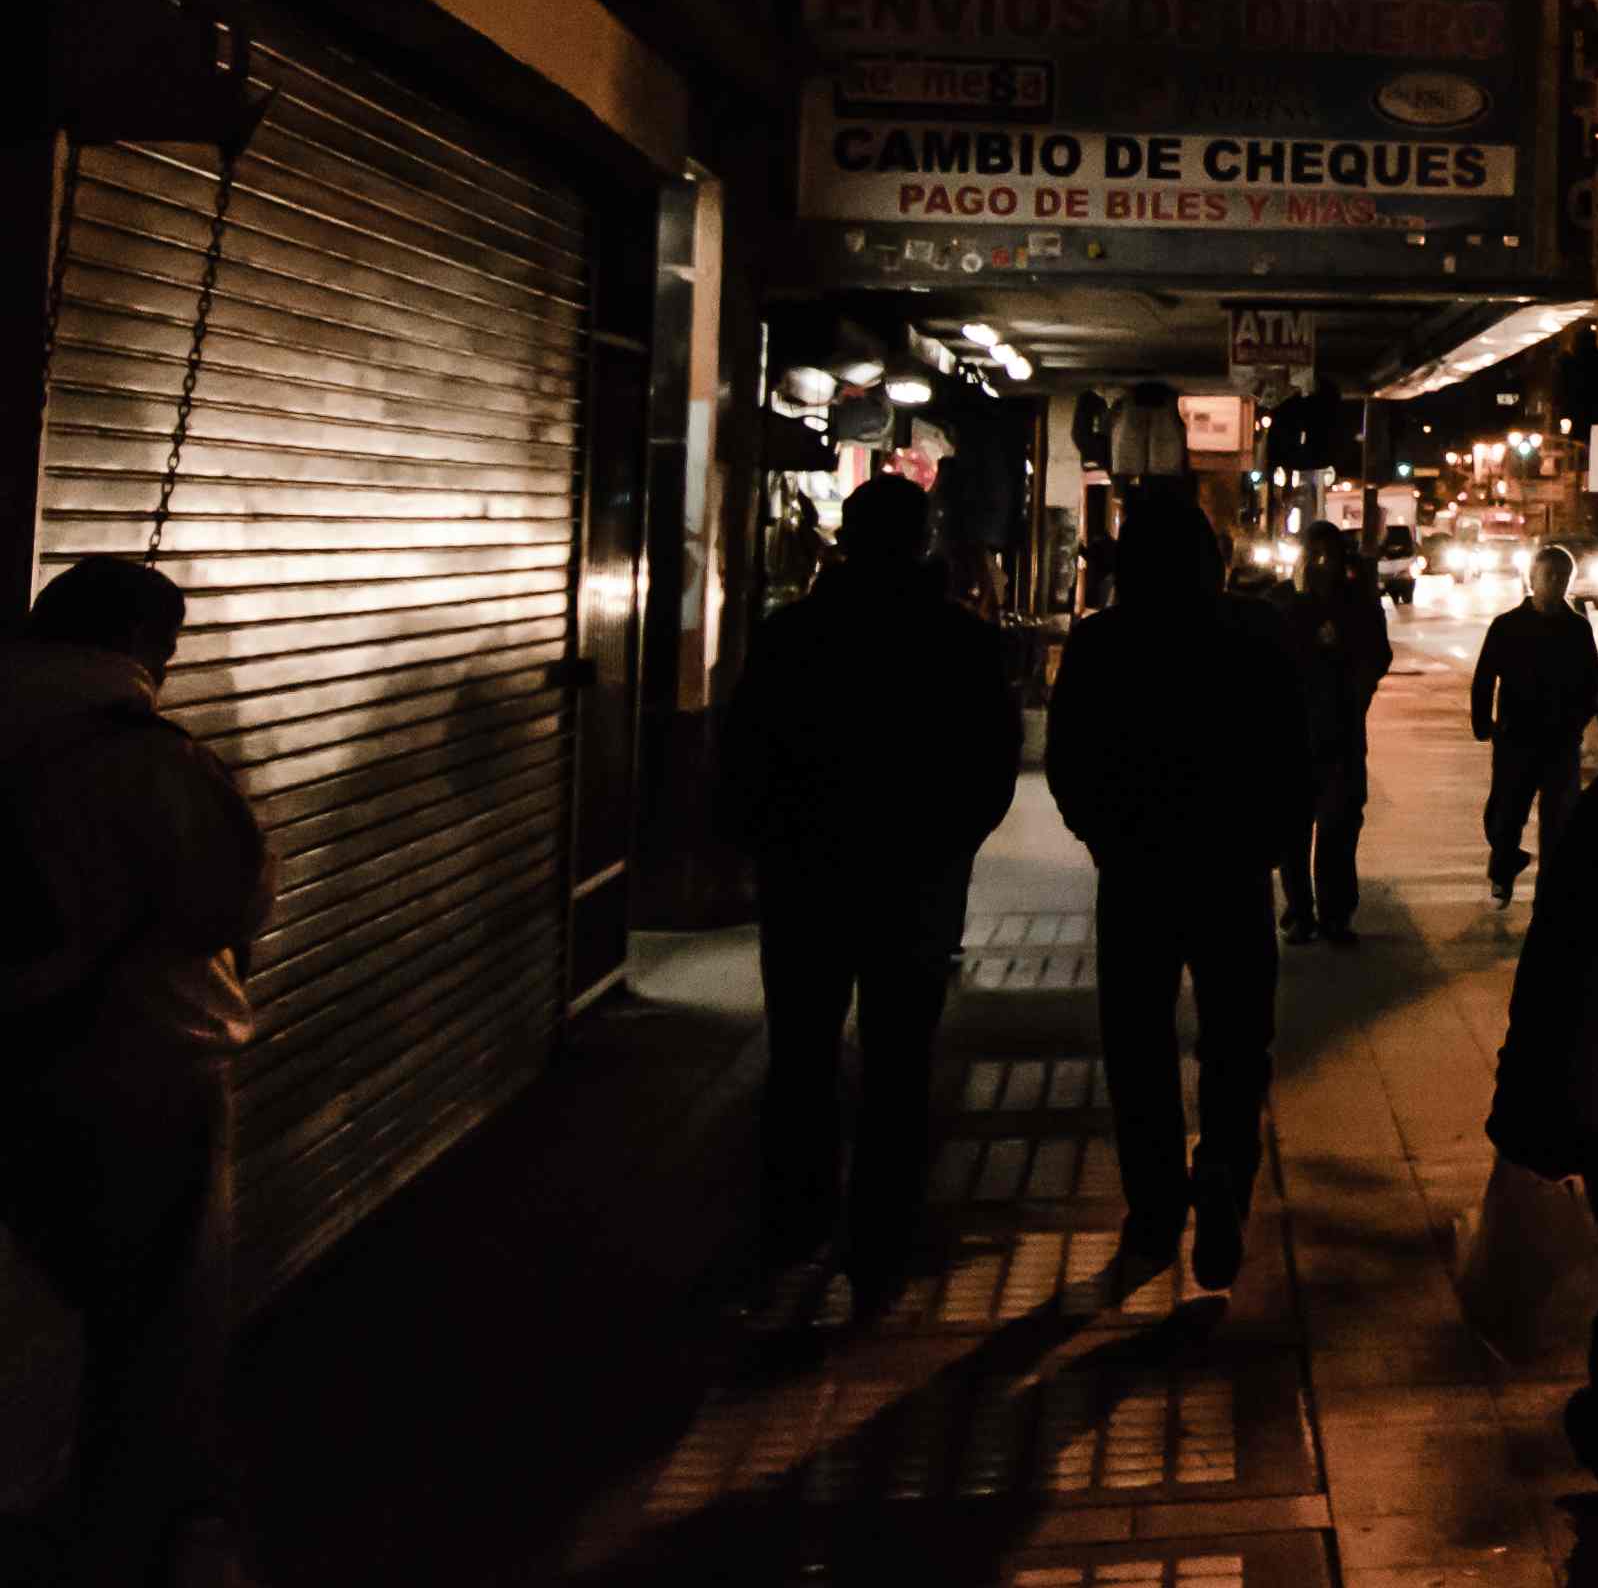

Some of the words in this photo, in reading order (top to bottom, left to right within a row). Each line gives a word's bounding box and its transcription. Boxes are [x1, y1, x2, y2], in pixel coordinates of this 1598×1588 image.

[834, 128, 1082, 178] CAMBIO
[1104, 136, 1181, 180] DE
[1202, 140, 1487, 188] CHEQUES
[899, 184, 1018, 217] PAGO
[1035, 188, 1089, 219] DE
[1105, 190, 1228, 222] BILES
[1244, 194, 1267, 223] Y
[1235, 308, 1313, 346] ATM
